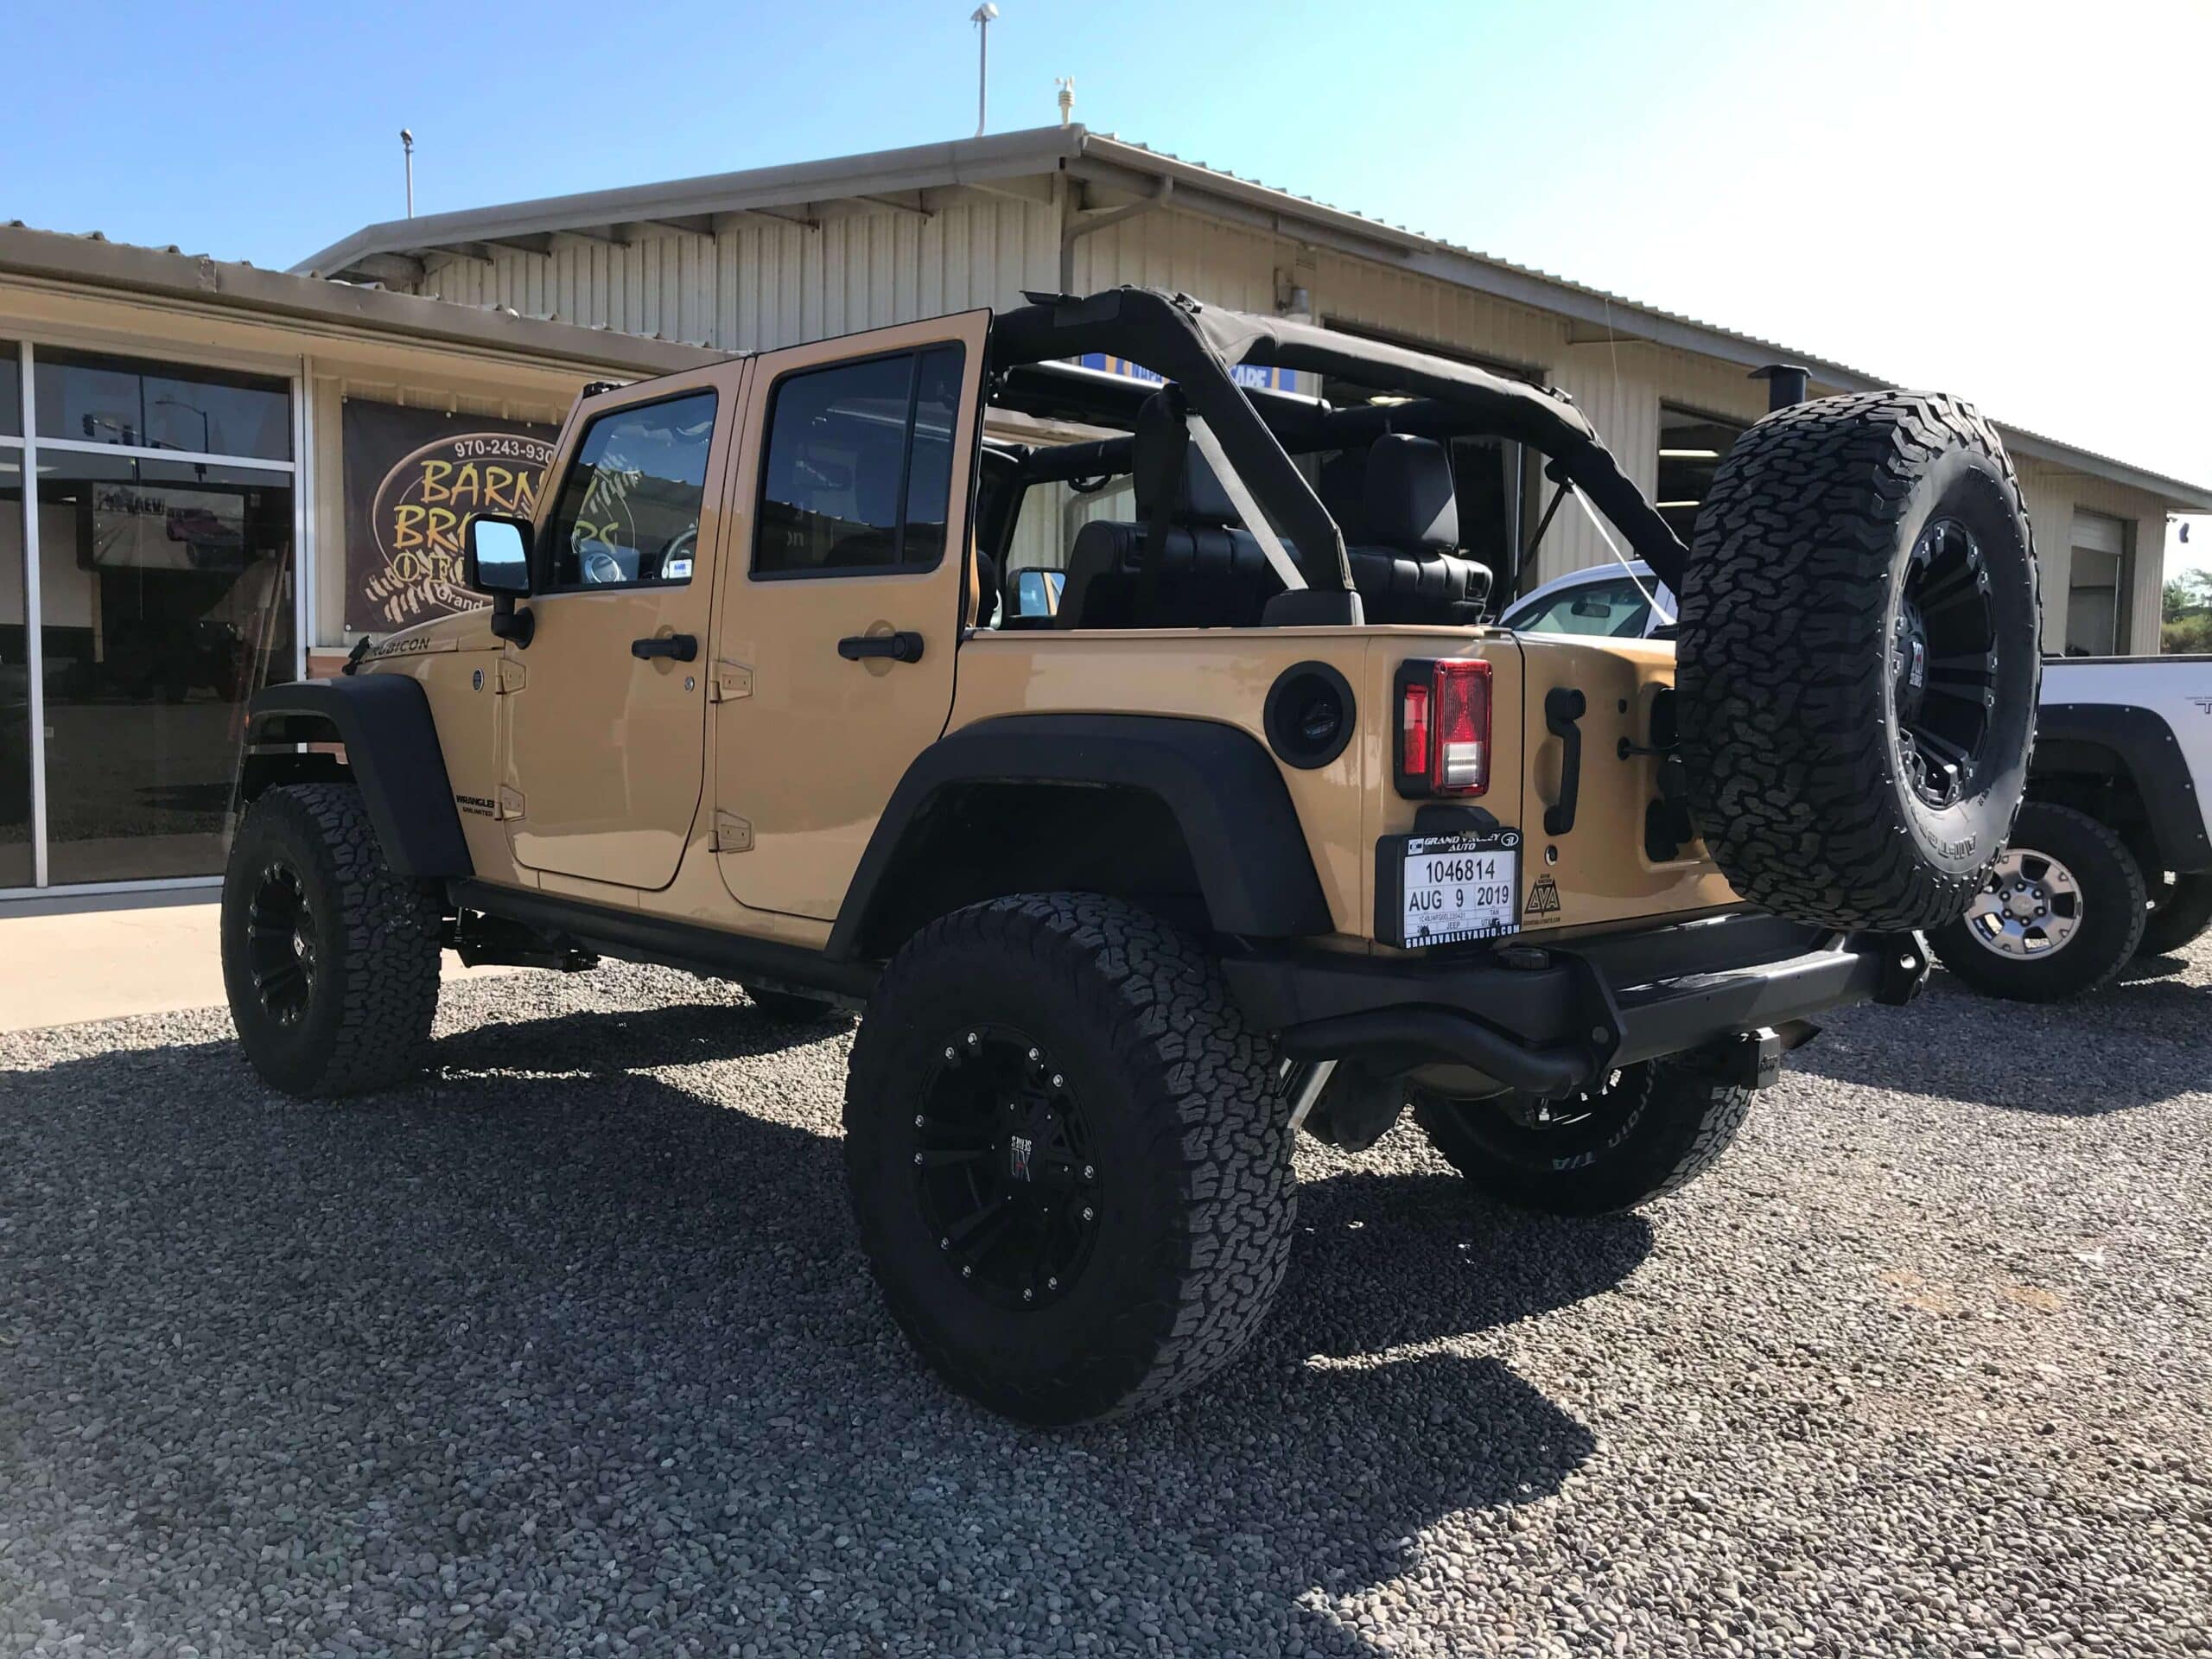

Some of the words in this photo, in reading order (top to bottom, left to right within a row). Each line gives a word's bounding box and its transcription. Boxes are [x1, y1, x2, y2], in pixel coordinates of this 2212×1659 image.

[435, 584, 483, 610] Grand
[372, 637, 430, 657] RUBICON
[456, 794, 495, 809] WRANGLER
[1424, 836, 1459, 848] GRAND
[1447, 843, 1476, 853] AUTO
[1426, 858, 1496, 884] 1046814
[1408, 889, 1442, 912] AUG
[1455, 888, 1464, 908] 9
[1477, 885, 1510, 906] 2019
[1446, 921, 1460, 931] JEEP
[1405, 924, 1521, 949] GRANDVALLEYAUTO.COM
